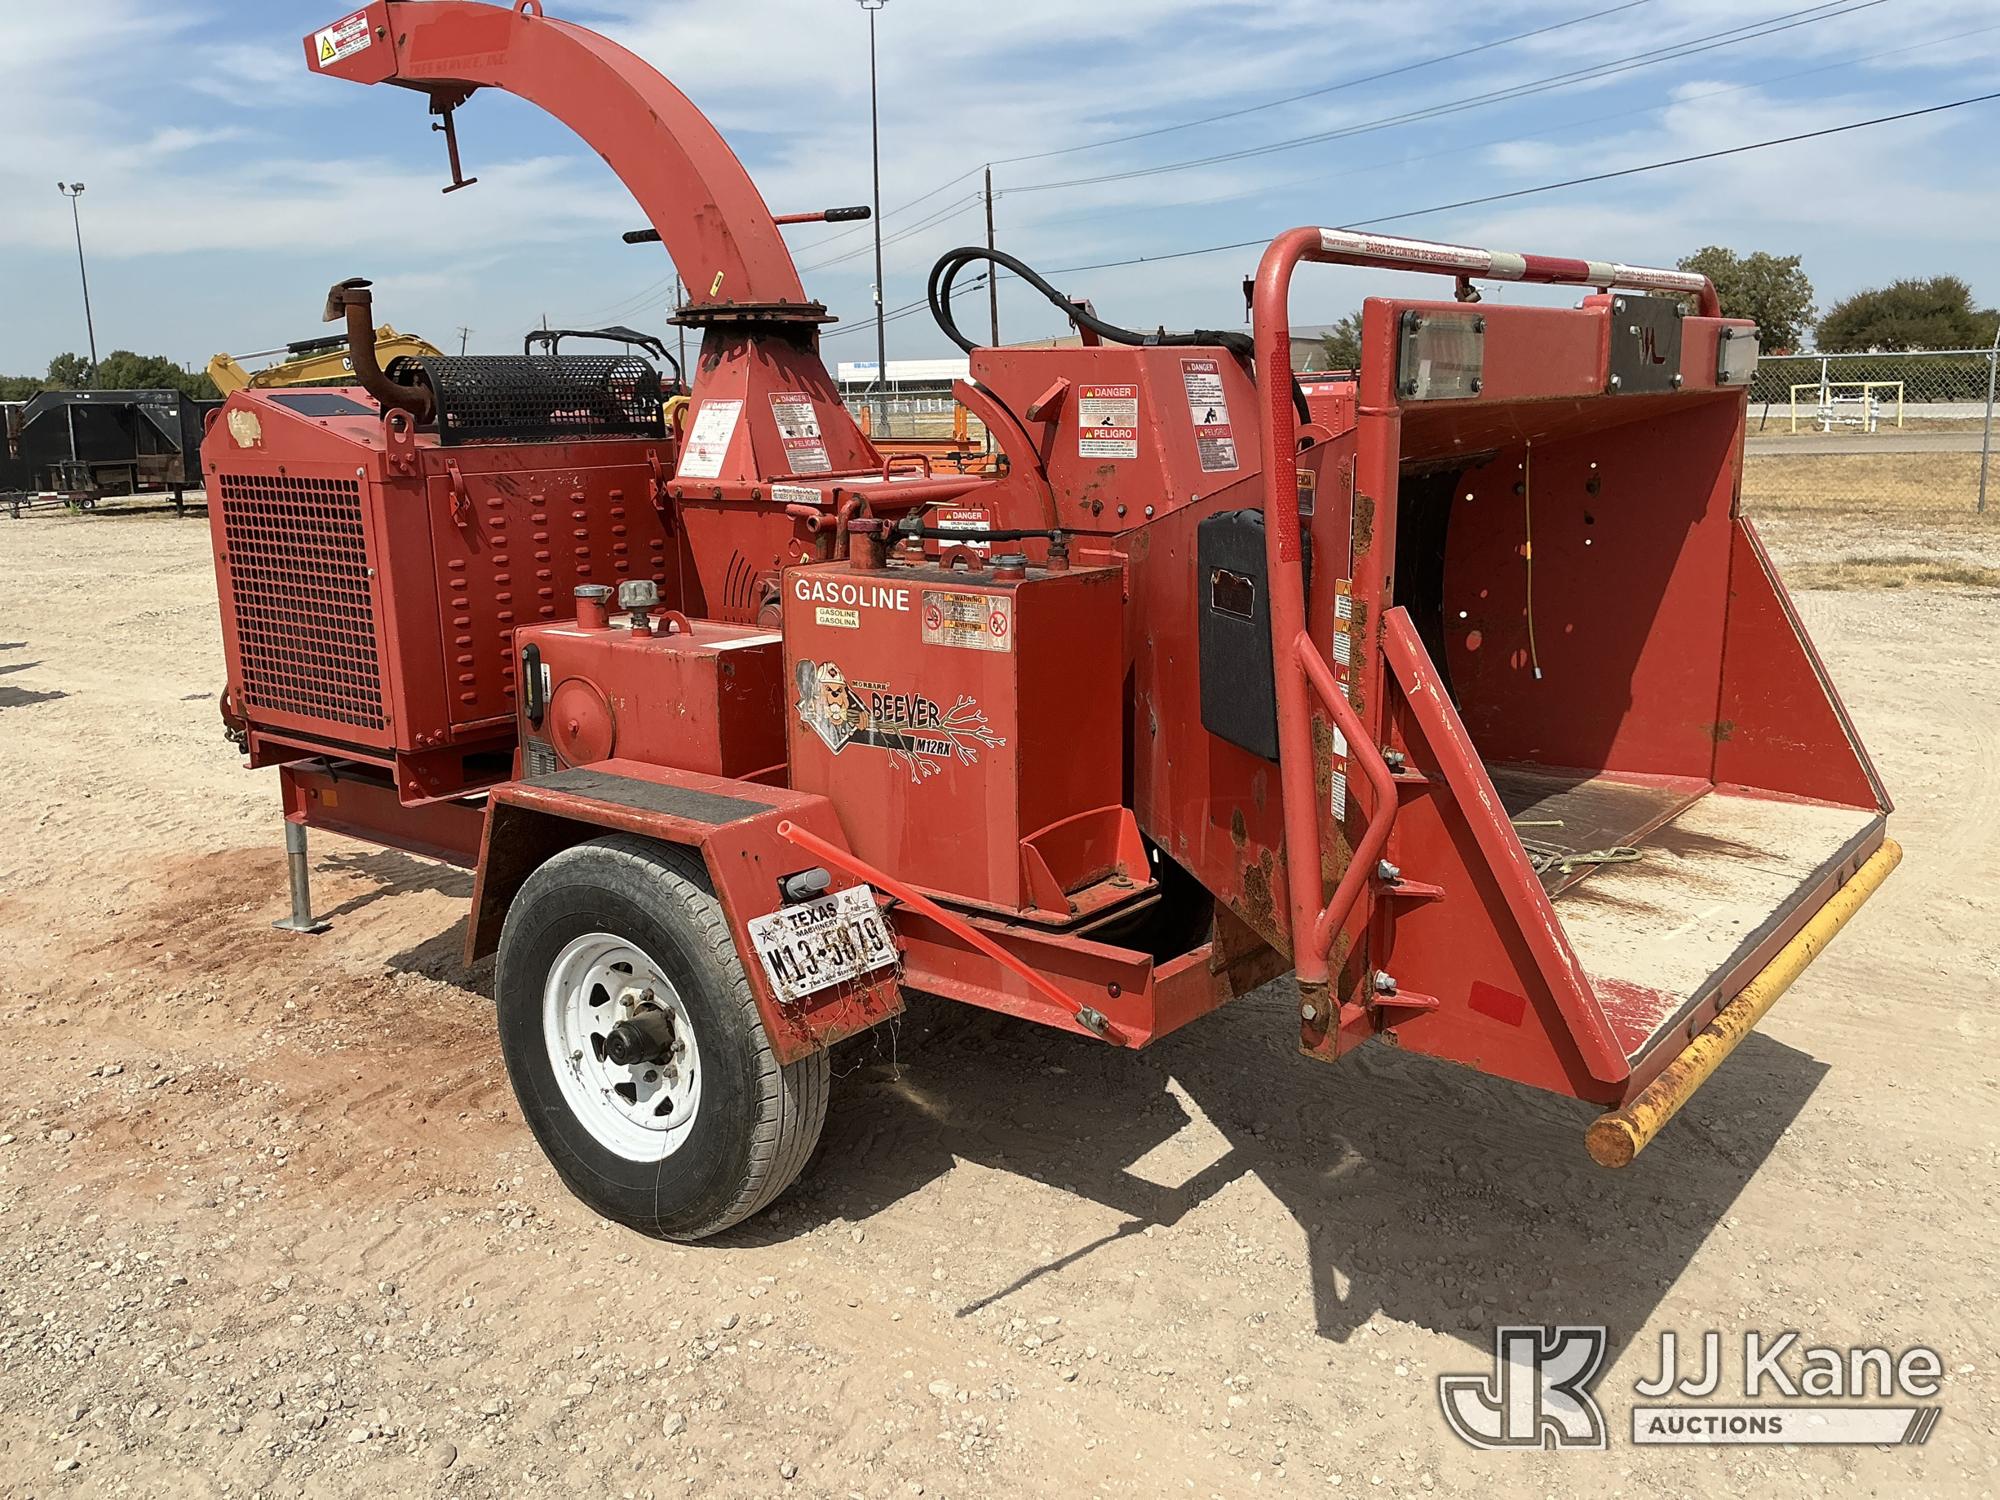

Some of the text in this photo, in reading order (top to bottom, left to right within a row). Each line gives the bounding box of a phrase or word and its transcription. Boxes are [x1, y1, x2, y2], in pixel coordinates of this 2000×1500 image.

[1191, 363, 1214, 371] DANGER
[1094, 387, 1131, 397] DANGER
[781, 394, 807, 402] DANGER
[1094, 429, 1132, 438] PELIGRO
[952, 511, 982, 520] DANGER
[795, 579, 910, 611] GASOLINE
[954, 594, 982, 603] WARNING
[819, 608, 857, 618] GASOLINE
[819, 617, 857, 627] GASOLINA
[872, 692, 940, 729] BEEVER
[916, 739, 951, 756] M12RX
[787, 902, 839, 930] TEXAS
[796, 918, 839, 938] MACHINERY
